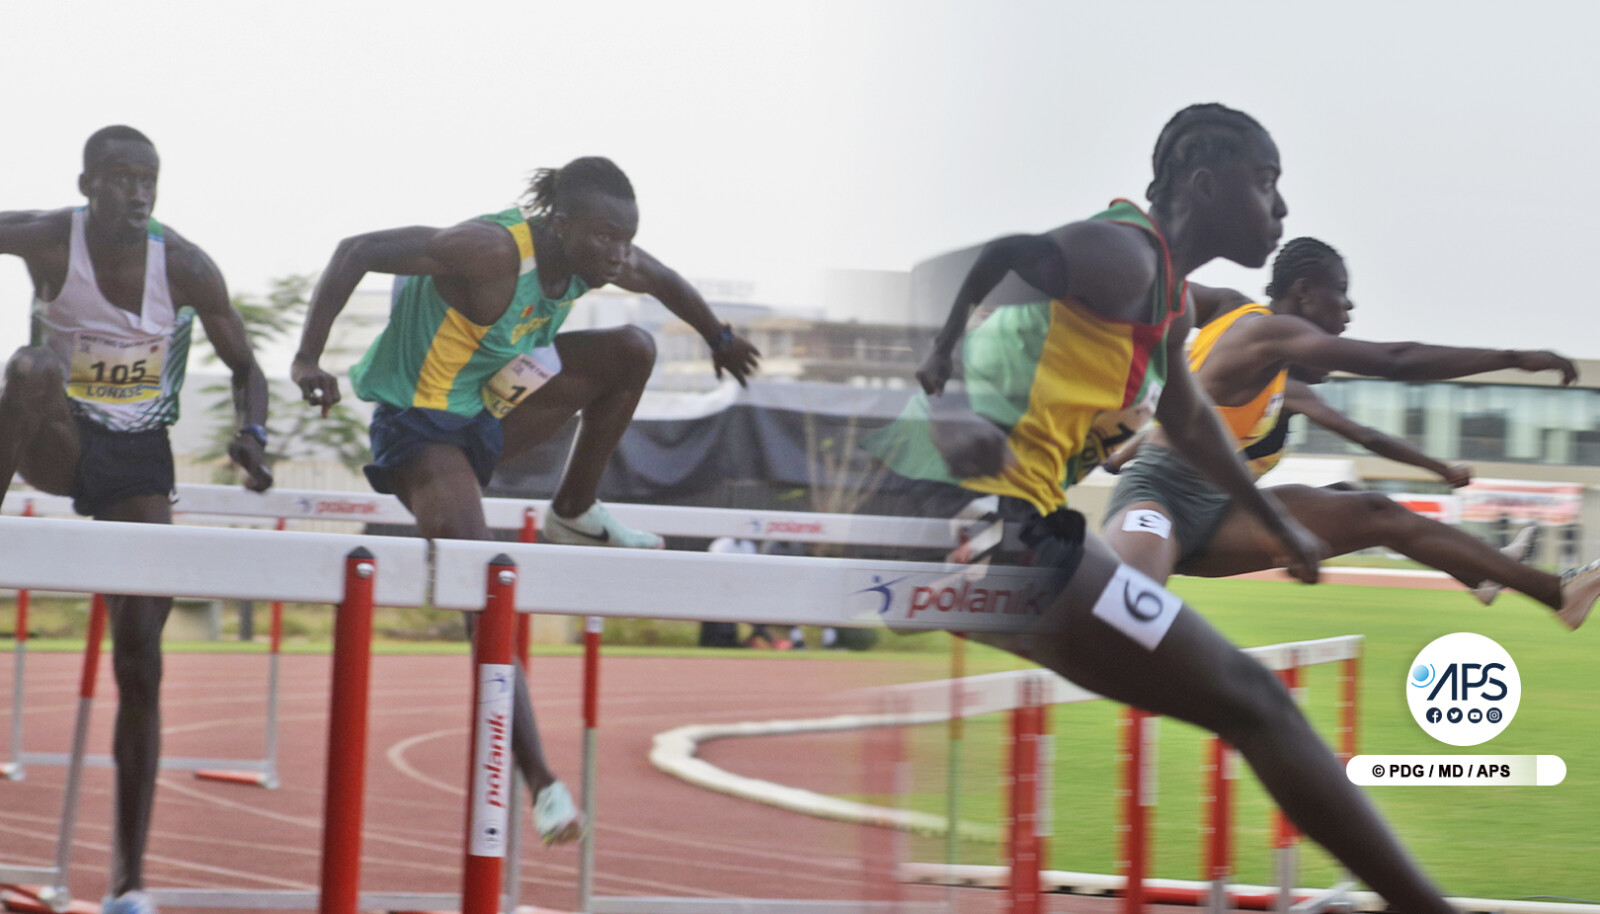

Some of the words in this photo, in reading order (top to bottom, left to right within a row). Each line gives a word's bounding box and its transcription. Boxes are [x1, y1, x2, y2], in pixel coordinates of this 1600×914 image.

[90, 360, 147, 385] 105
[86, 385, 143, 399] LONASE
[906, 580, 1042, 618] polanik
[484, 711, 506, 808] polanik
